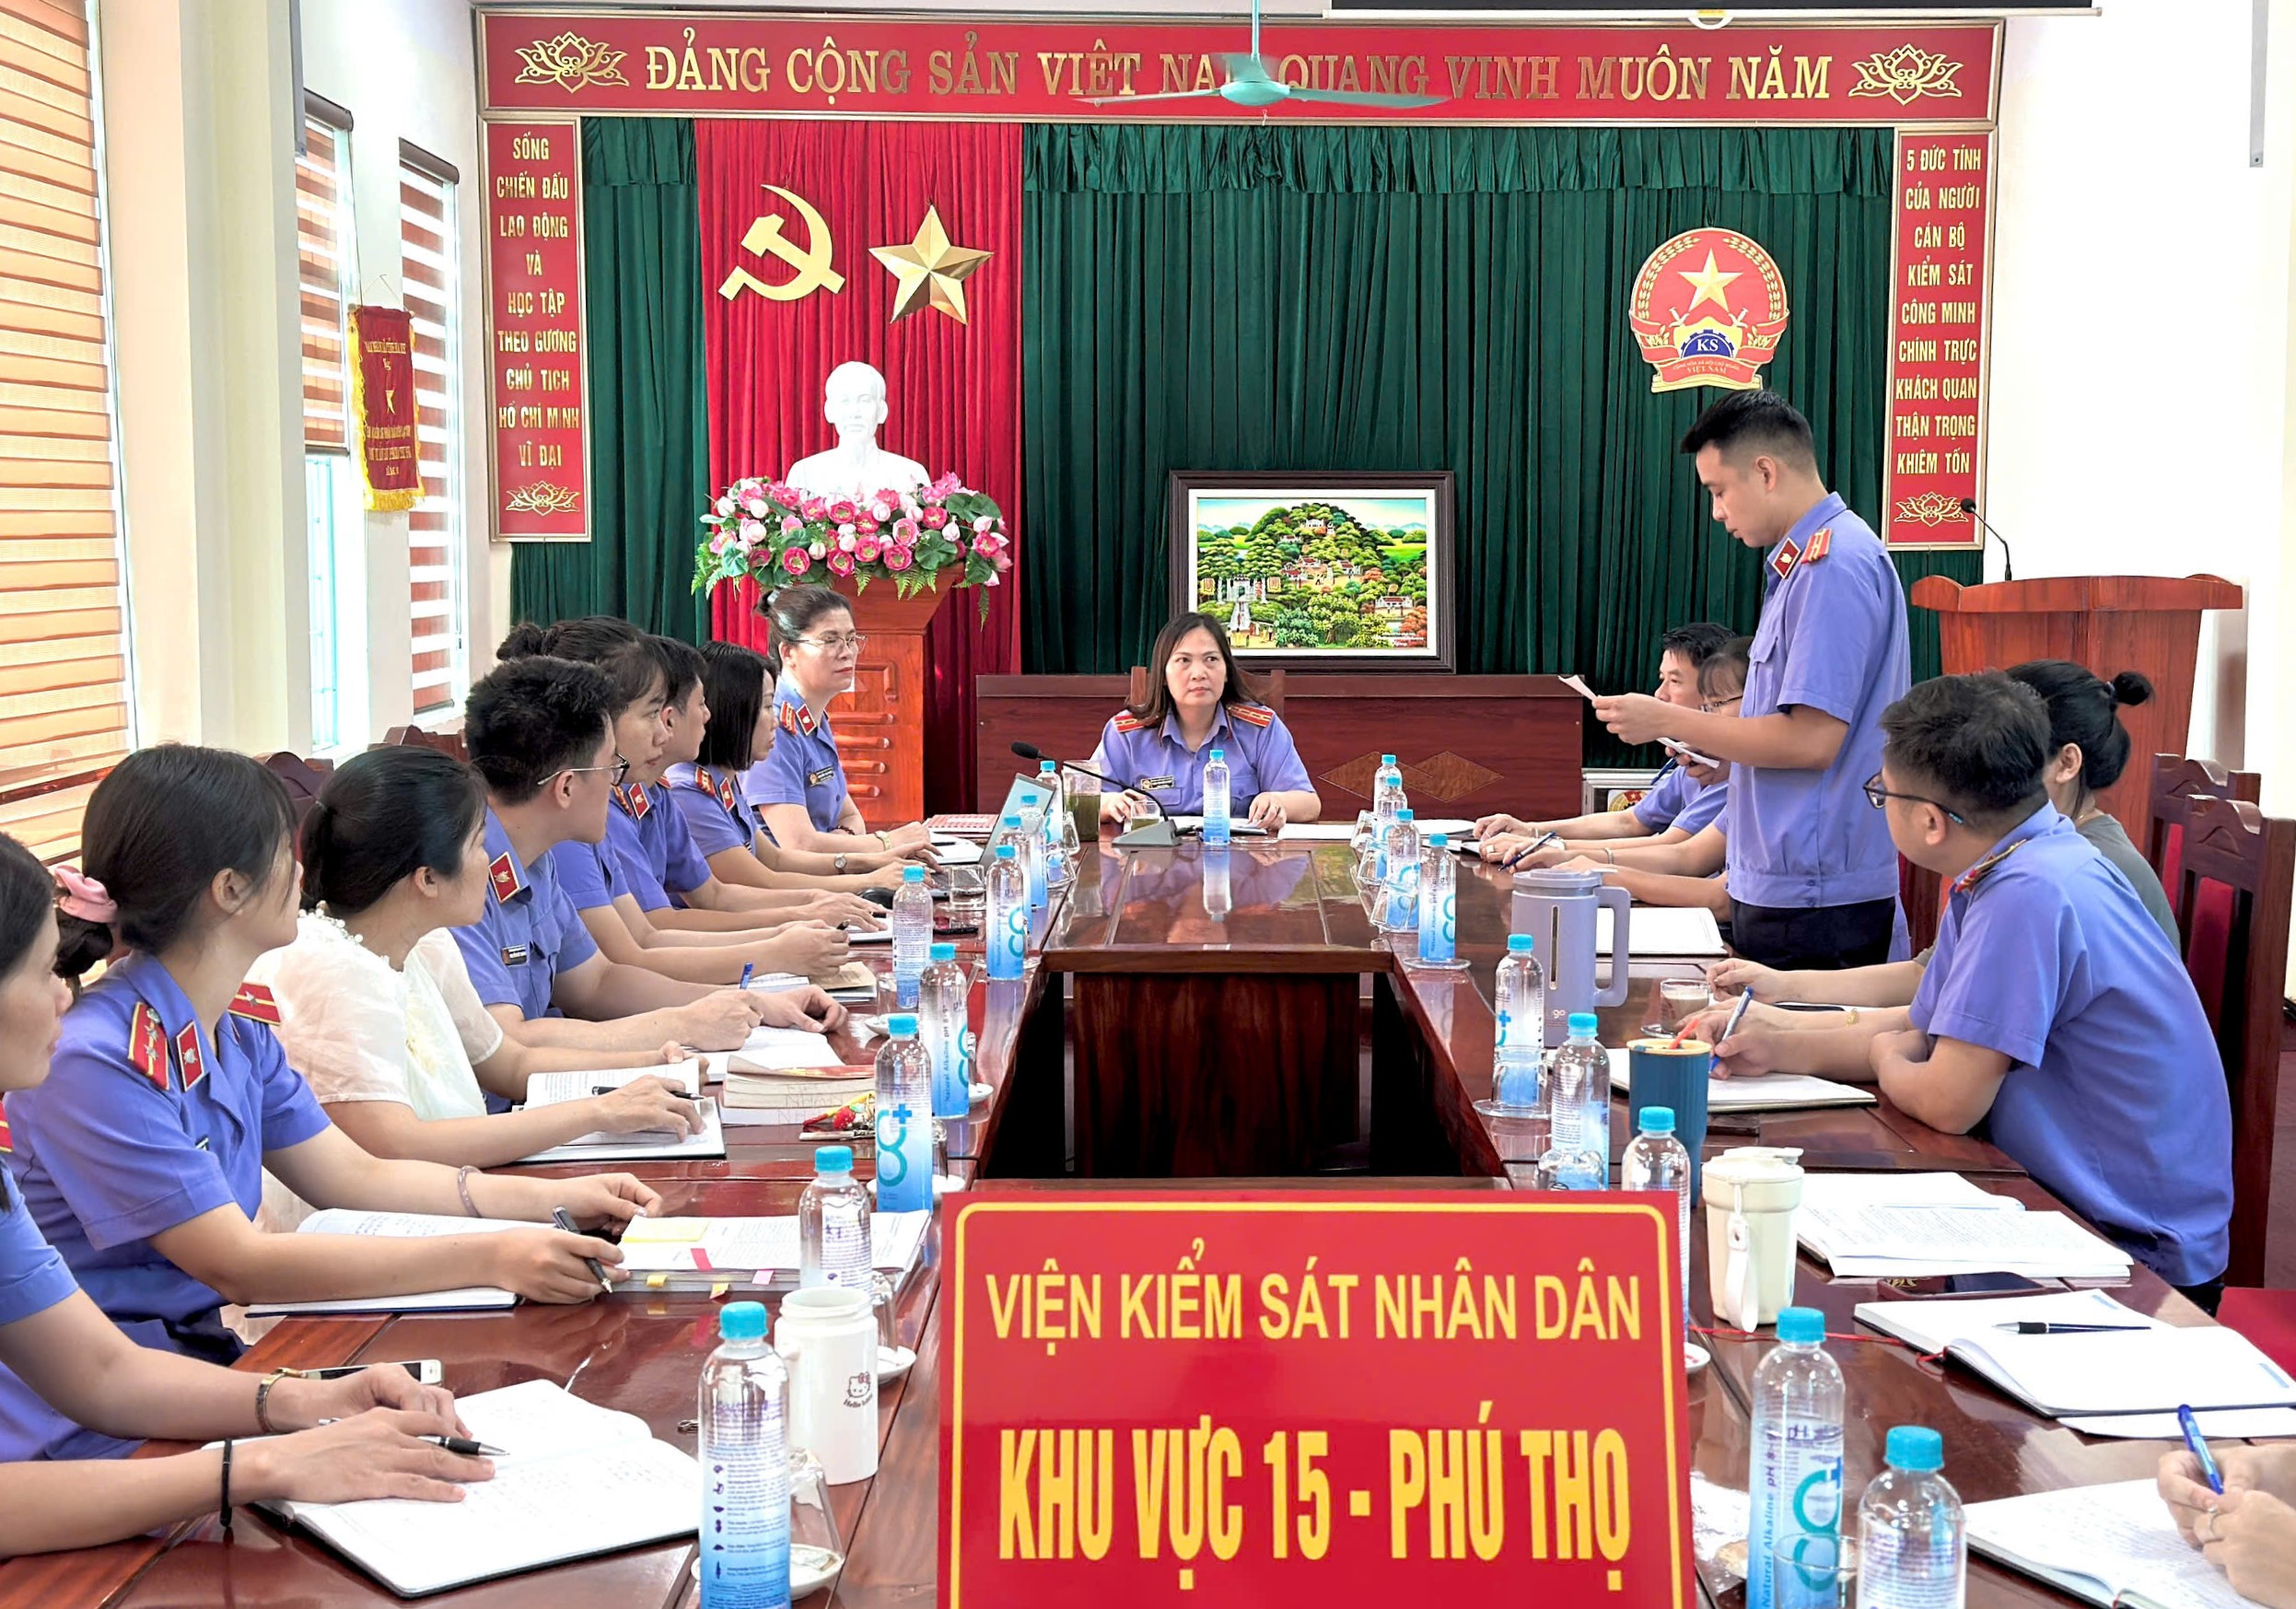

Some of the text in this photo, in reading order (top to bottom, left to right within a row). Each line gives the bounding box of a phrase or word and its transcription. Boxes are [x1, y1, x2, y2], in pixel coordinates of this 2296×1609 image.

[645, 27, 1832, 108] ĐẢNG CỘNG SẢN VIỆT NA QUANG VINH MUÔN NĂM
[513, 132, 550, 160] SỐNG
[1906, 144, 1981, 171] 5 ĐỨC TÍNH
[496, 170, 568, 200] CHIẾN ĐẤU
[1906, 181, 1980, 210] CỦA NGƯỜI
[500, 212, 568, 241] LAO ĐỘNG
[1915, 222, 1965, 251] CÁN BỘ
[526, 250, 542, 275] VÀ
[1907, 255, 1974, 286] KIỂM SÁT
[508, 288, 565, 318] HỌC TẬP
[1902, 298, 1975, 324] CÔNG MINH
[497, 328, 577, 353] THEO GƯƠNG
[1696, 338, 1719, 352] KS
[1899, 337, 1977, 365] CHÍNH TRỰC
[506, 362, 532, 391] CHỦ
[1895, 374, 1977, 402] KHÁCH QUAN
[498, 400, 516, 428] HỒ
[547, 407, 579, 428] MINH
[1895, 412, 1975, 440] THẬN TRỌNG
[539, 445, 562, 471] ĐẠI
[1896, 447, 1970, 474] KHIÊM TỐN
[986, 1238, 1641, 1356] VIỆN KIỂM SÁT NHÂN DÂN
[1766, 1465, 1777, 1487] pH
[999, 1401, 1631, 1591] KHU VỰC 15 - PHÚ THỌ
[1762, 1493, 1776, 1549] Alkaline
[1761, 1555, 1773, 1608] Natural
